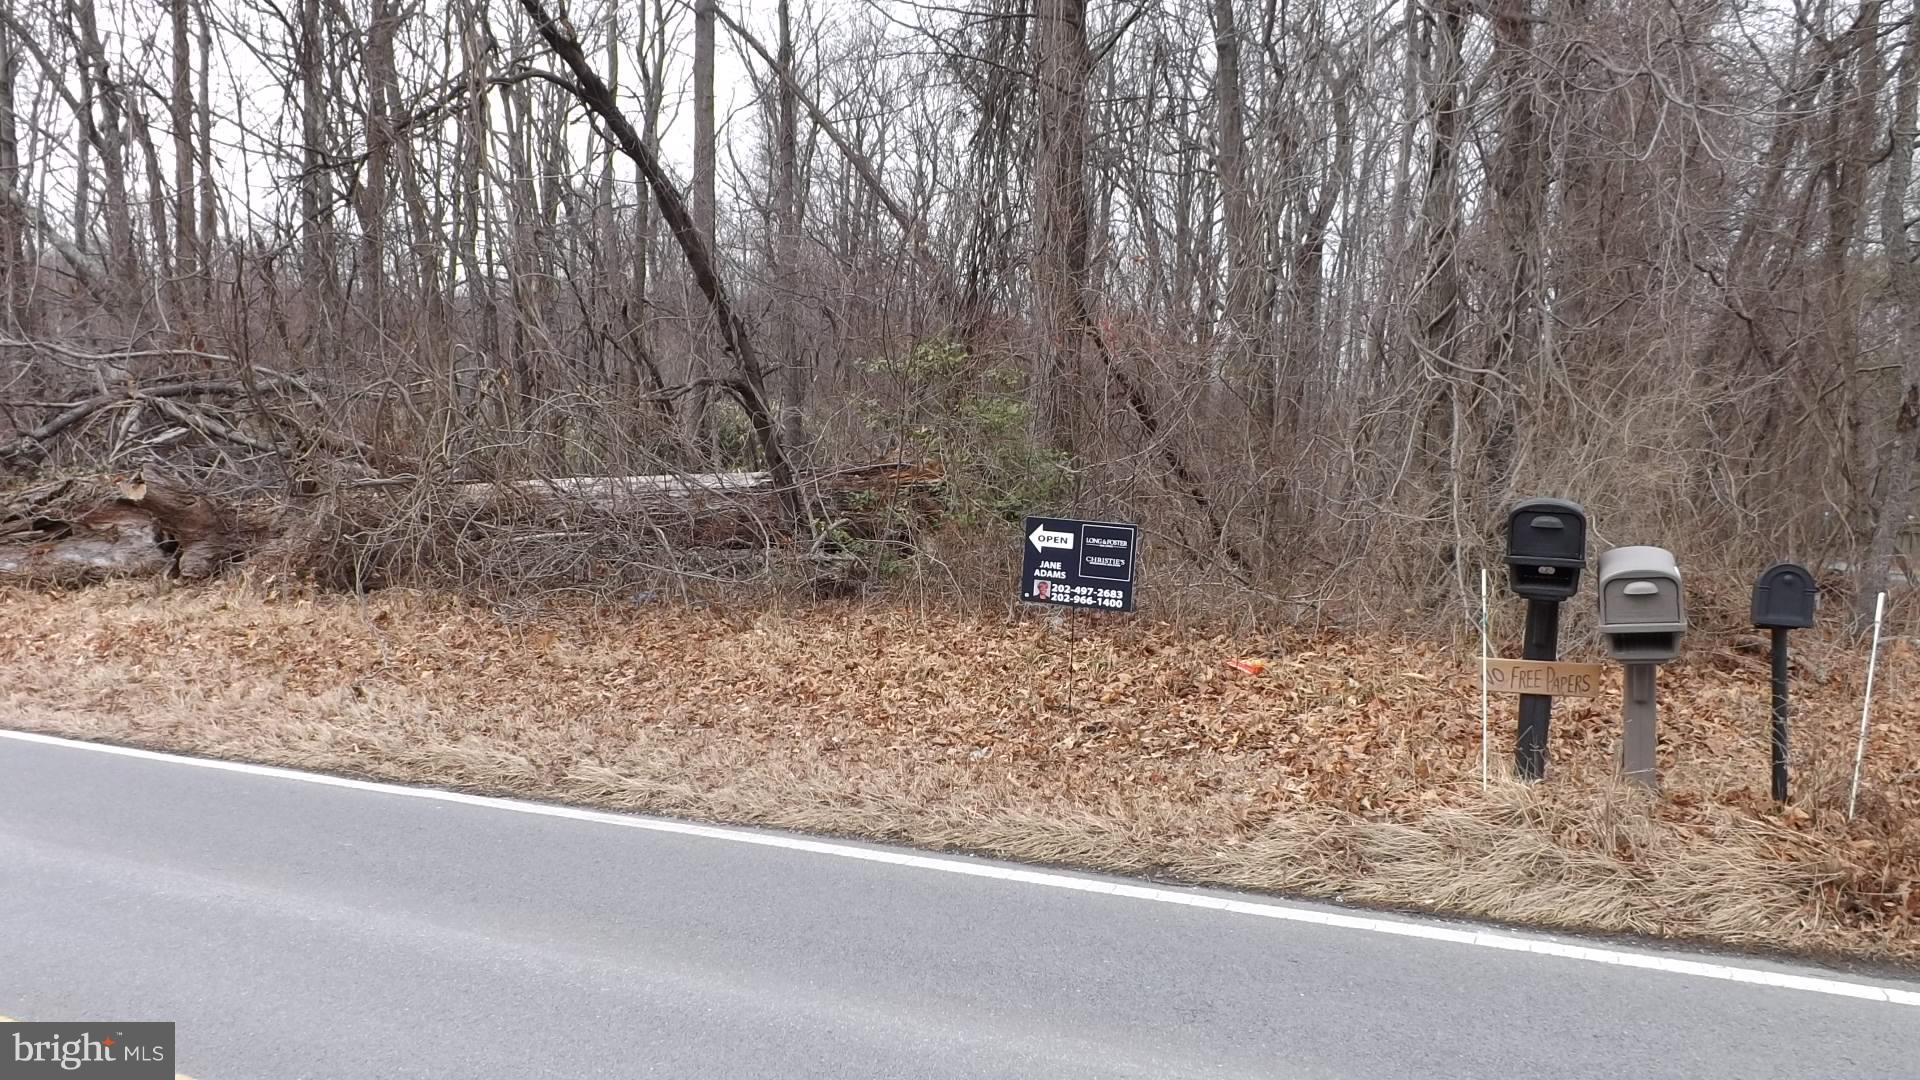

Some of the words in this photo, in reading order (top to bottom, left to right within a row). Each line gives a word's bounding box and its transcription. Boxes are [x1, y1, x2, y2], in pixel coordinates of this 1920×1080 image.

[1038, 535, 1068, 544] OPEN
[1039, 560, 1062, 569] JANE
[1034, 569, 1066, 579] ADAMS
[1051, 584, 1123, 599] 202-497-2683
[1051, 593, 1123, 608] 202-966-1400
[1510, 666, 1542, 689] FREE
[1546, 666, 1591, 693] PAPERS
